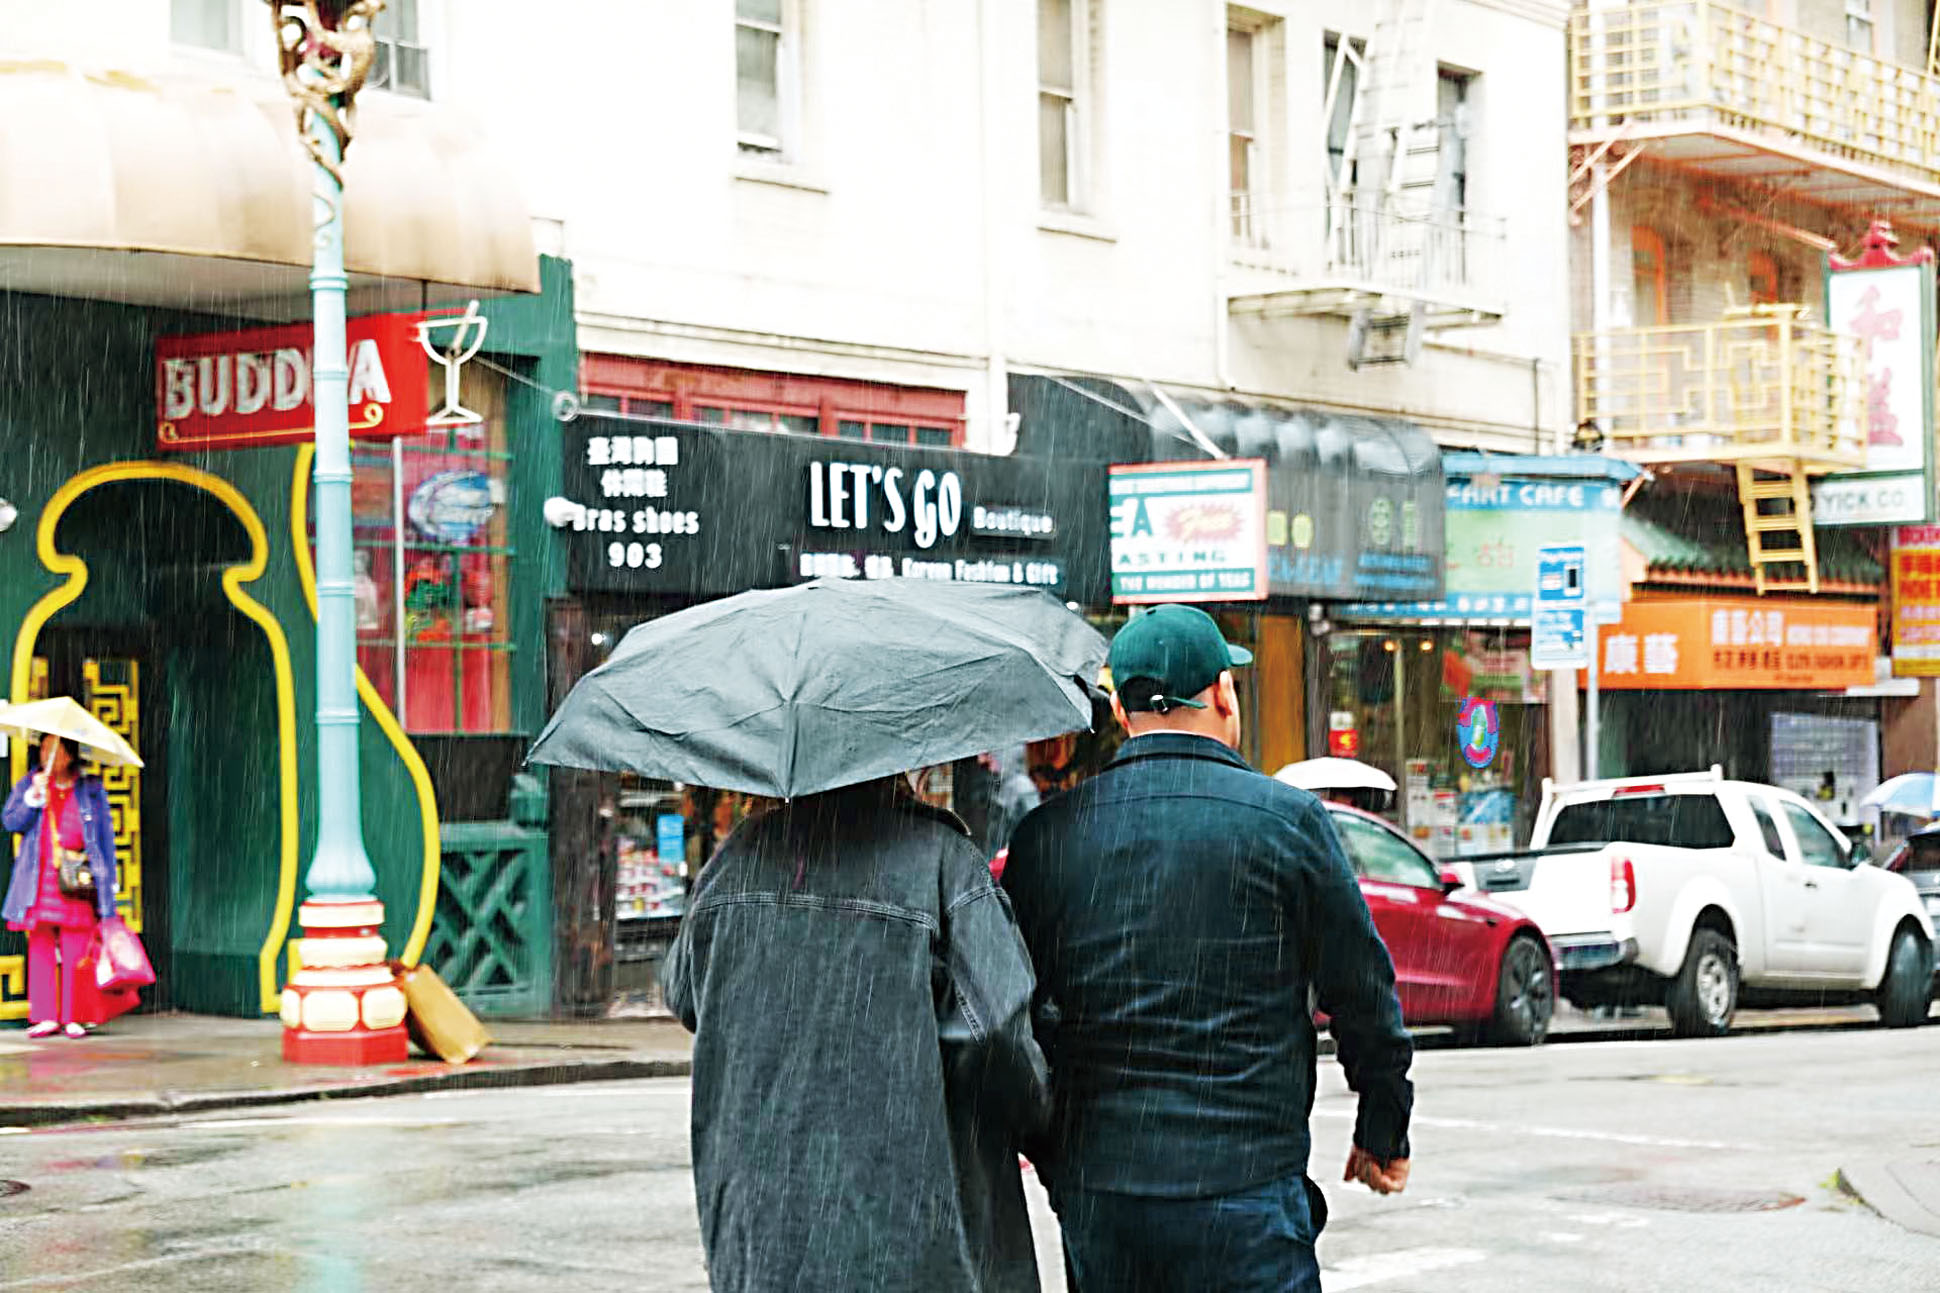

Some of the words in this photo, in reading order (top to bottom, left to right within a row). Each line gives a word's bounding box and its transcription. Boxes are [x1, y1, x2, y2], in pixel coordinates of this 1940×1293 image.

[161, 339, 392, 421] BUDDA
[632, 505, 699, 535] shoes
[810, 461, 906, 533] LET'S
[914, 469, 961, 548] GO
[973, 506, 1053, 536] Boutique
[608, 541, 662, 569] 903
